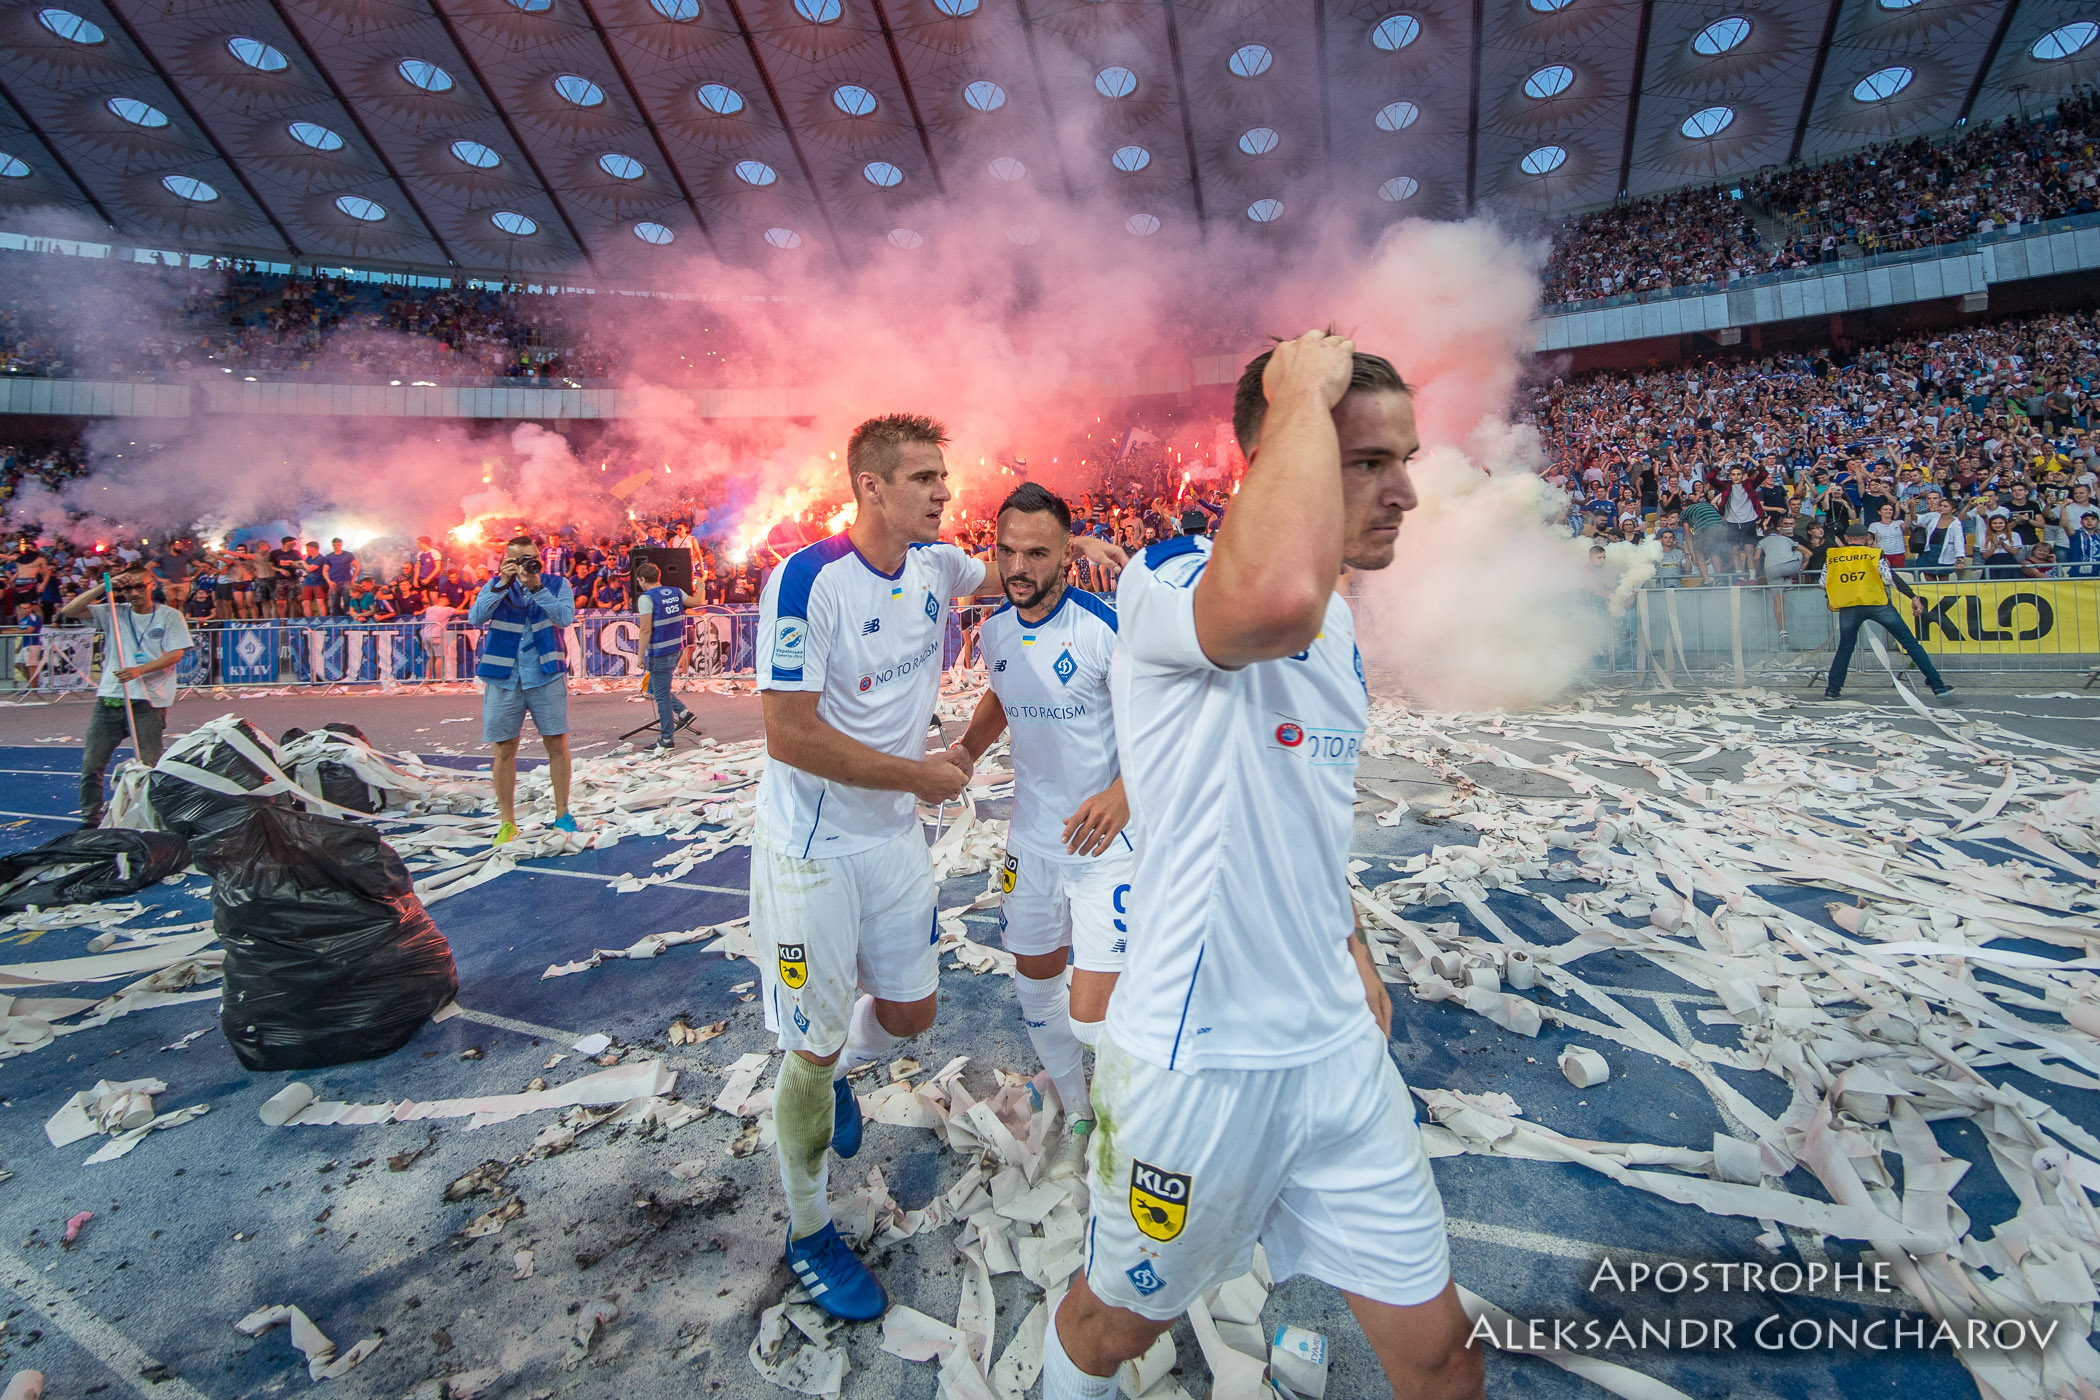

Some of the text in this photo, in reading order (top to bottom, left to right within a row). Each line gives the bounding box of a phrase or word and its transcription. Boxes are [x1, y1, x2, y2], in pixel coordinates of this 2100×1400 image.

[1828, 553, 1876, 565] SECURITY
[1840, 571, 1866, 583] 067
[661, 596, 680, 605] PHOTO
[665, 604, 680, 615] 025
[1915, 593, 2054, 641] KLO
[230, 664, 272, 676] KYIV
[876, 669, 893, 686] NO
[897, 662, 911, 676] TO
[1004, 704, 1086, 720] NO TO RACISM
[1323, 736, 1344, 758] TO
[779, 945, 803, 960] KLO
[1135, 1165, 1186, 1200] KLO
